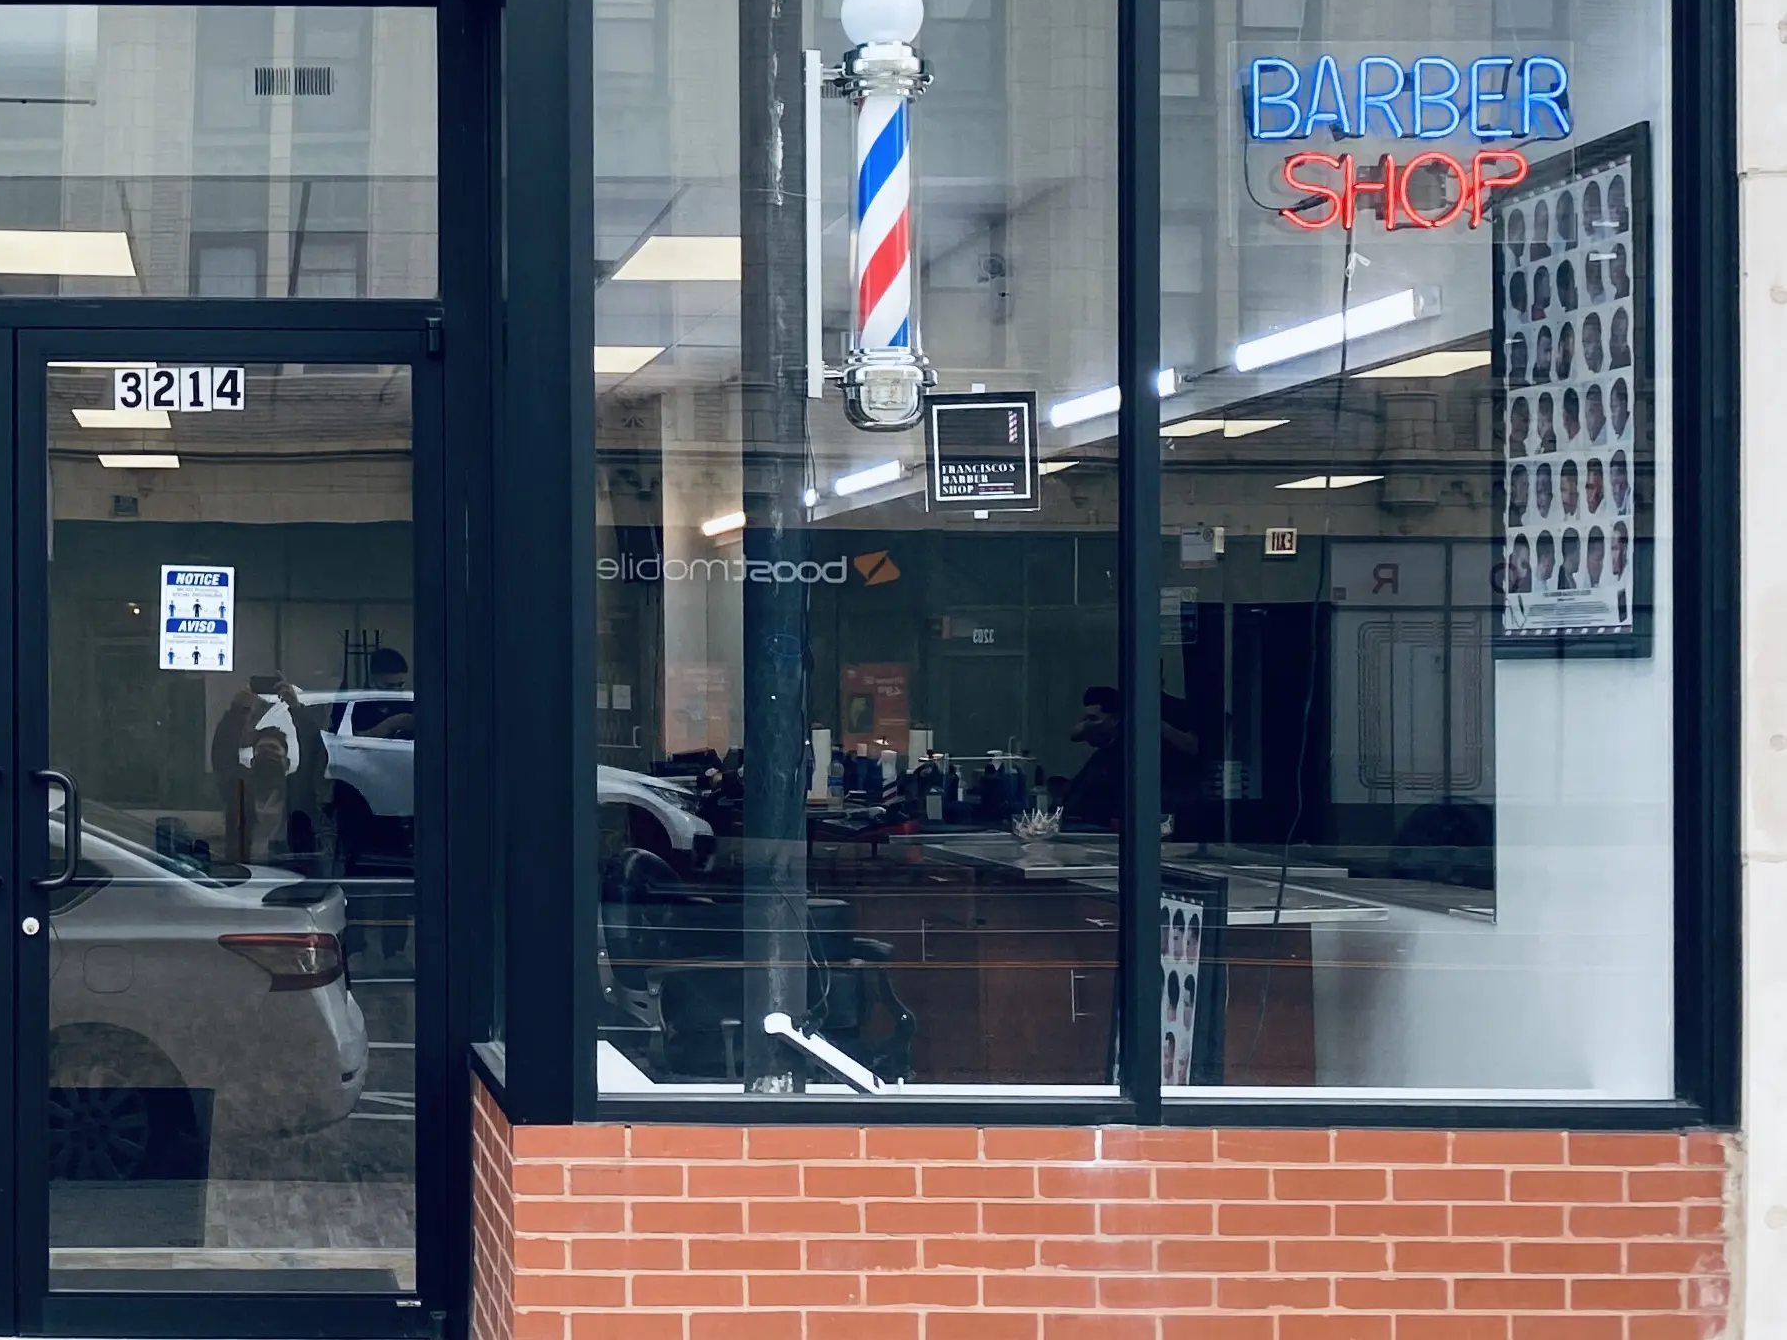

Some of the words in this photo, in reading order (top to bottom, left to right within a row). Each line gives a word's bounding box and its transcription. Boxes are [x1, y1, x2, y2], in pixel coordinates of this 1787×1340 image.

[1250, 55, 1571, 139] BARBER
[1279, 149, 1530, 230] SHOP
[120, 370, 241, 408] 3214
[942, 474, 989, 485] BARBER
[942, 484, 974, 495] SHOP
[175, 572, 221, 586] NOTICE
[177, 620, 216, 633] AVISO
